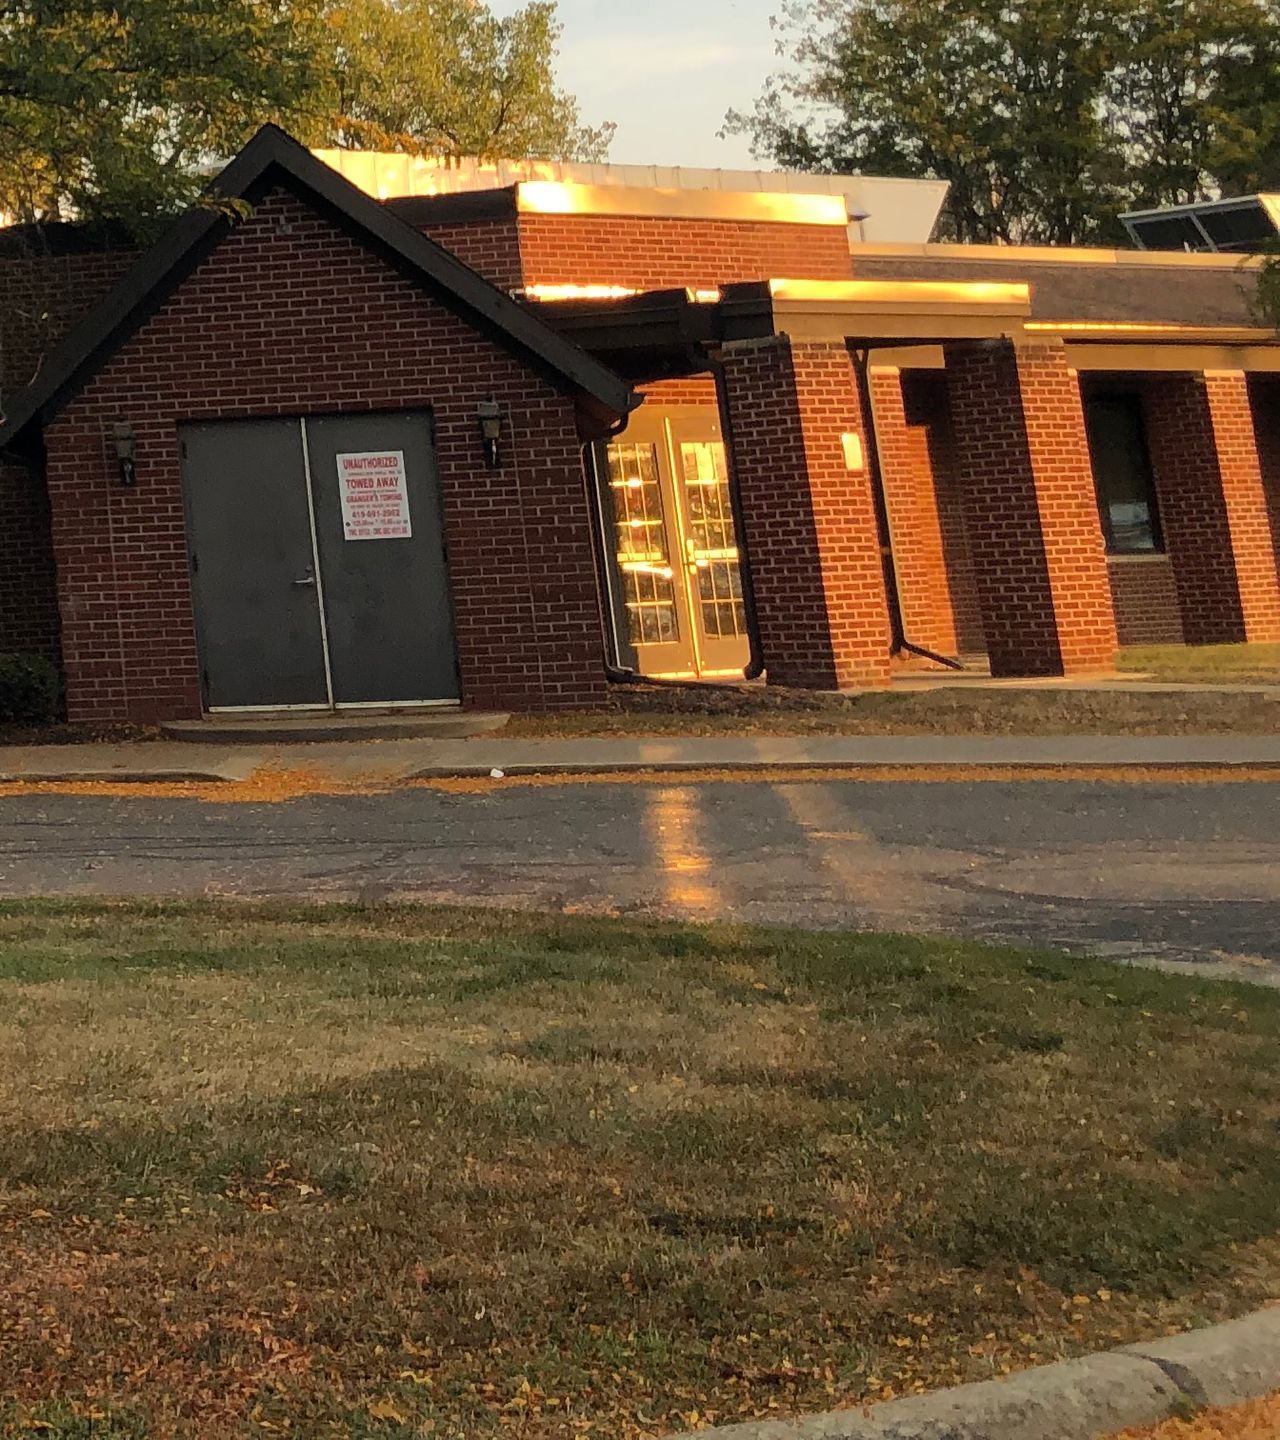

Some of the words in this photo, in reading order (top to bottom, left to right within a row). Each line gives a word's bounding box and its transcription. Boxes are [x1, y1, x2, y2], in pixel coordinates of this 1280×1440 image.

[343, 457, 398, 469] UNAUTHORIZED
[346, 478, 374, 489] TOWED
[377, 477, 399, 487] AWAY
